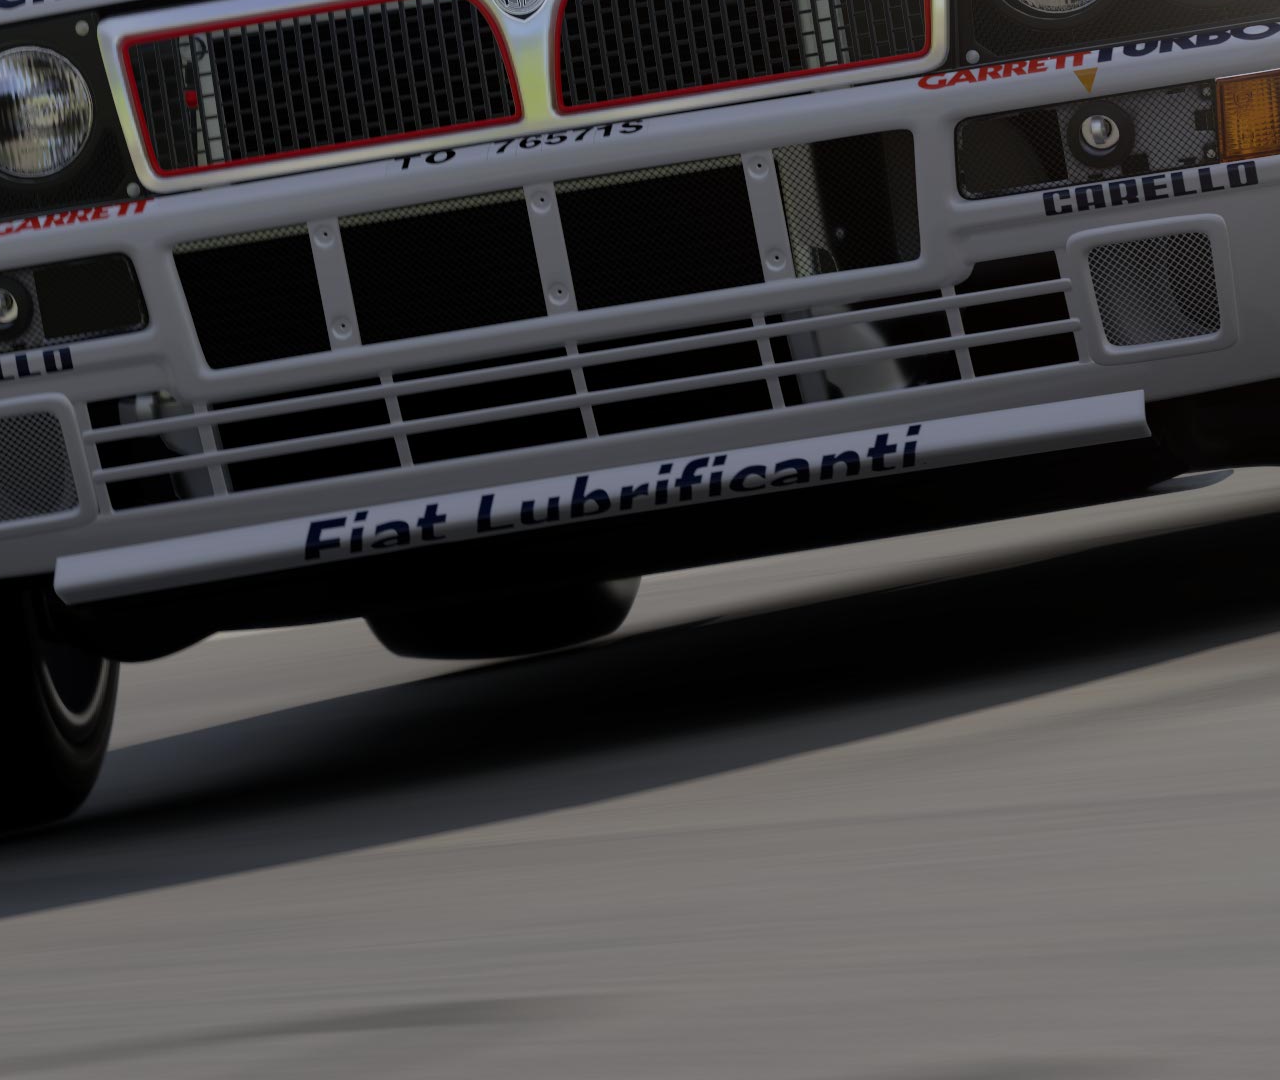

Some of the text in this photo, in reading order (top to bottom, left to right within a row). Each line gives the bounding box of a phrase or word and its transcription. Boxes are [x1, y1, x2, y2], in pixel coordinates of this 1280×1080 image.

[917, 49, 1097, 90] GARRETT
[1042, 160, 1259, 217] CARELLO
[303, 423, 923, 562] Fiat Lubrificanti
